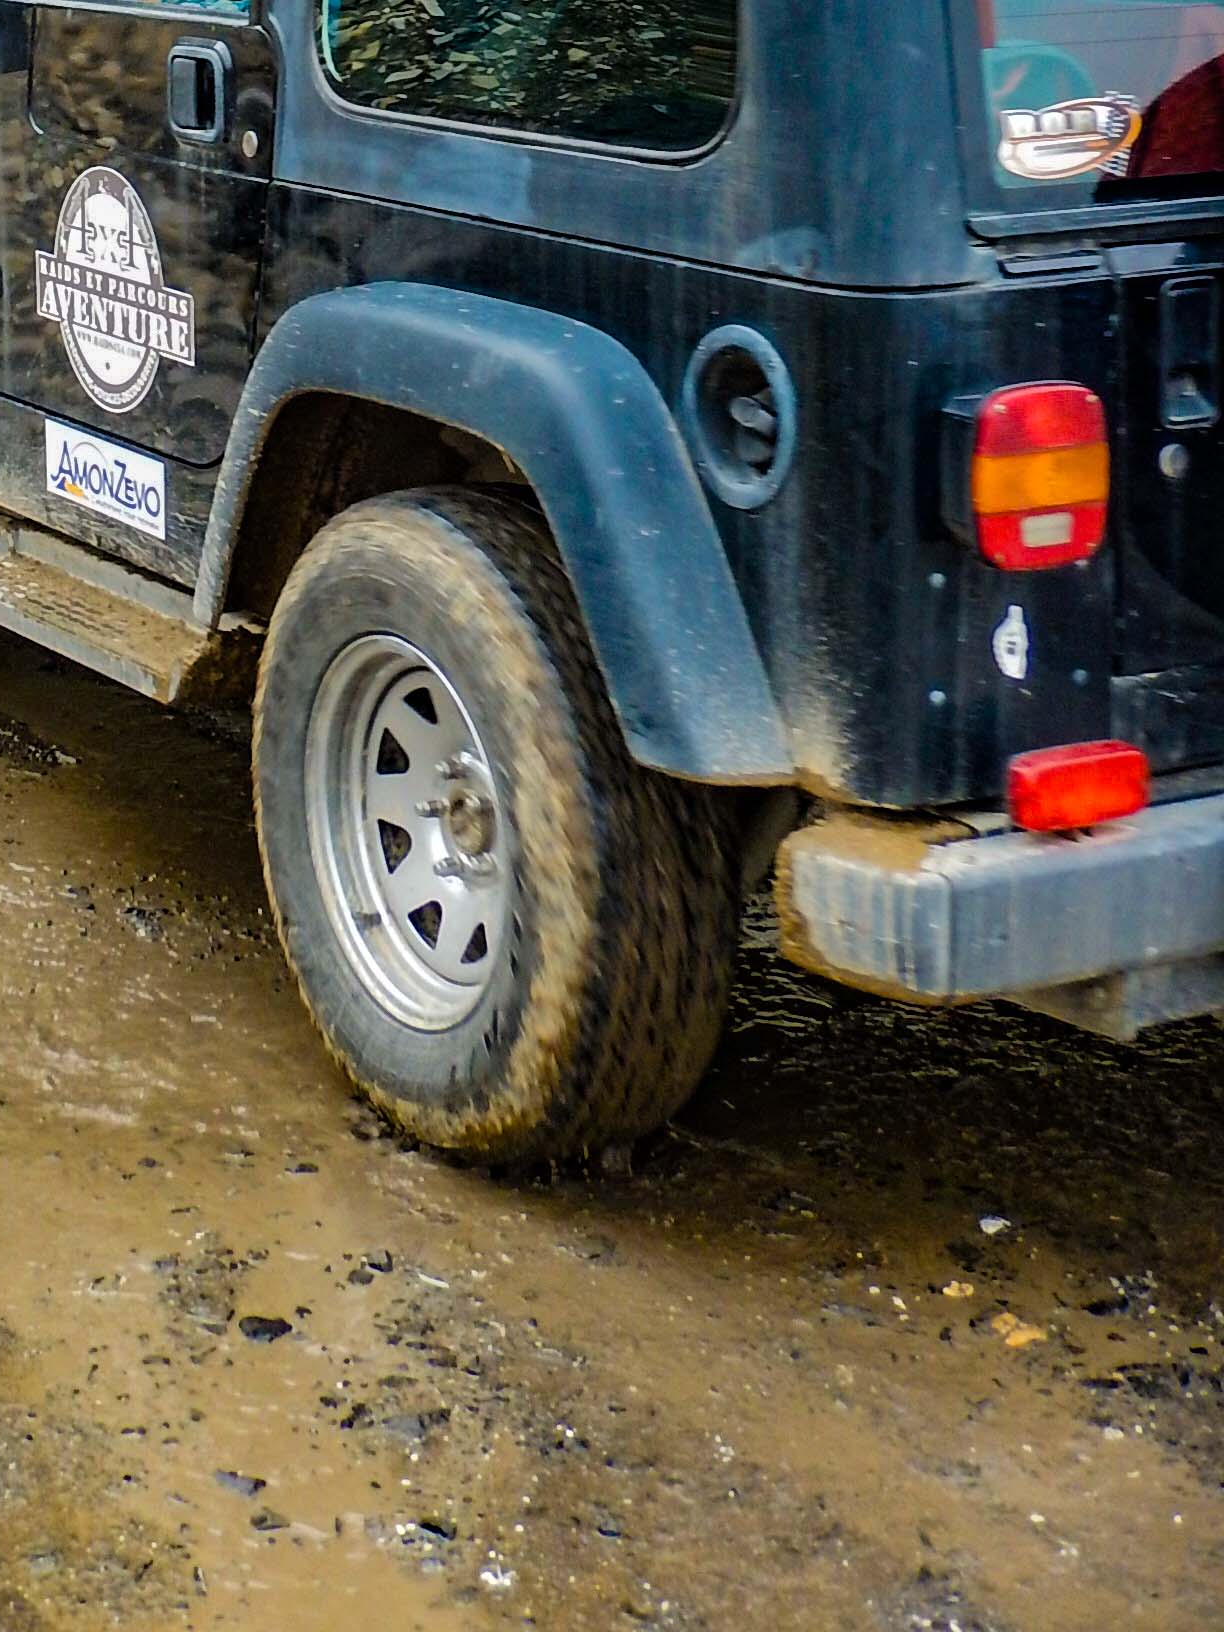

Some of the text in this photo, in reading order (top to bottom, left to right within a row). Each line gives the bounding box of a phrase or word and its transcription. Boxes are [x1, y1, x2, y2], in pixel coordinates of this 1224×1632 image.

[39, 257, 188, 317] RAIDS ET PARCOURS
[41, 280, 189, 358] AVENTURE
